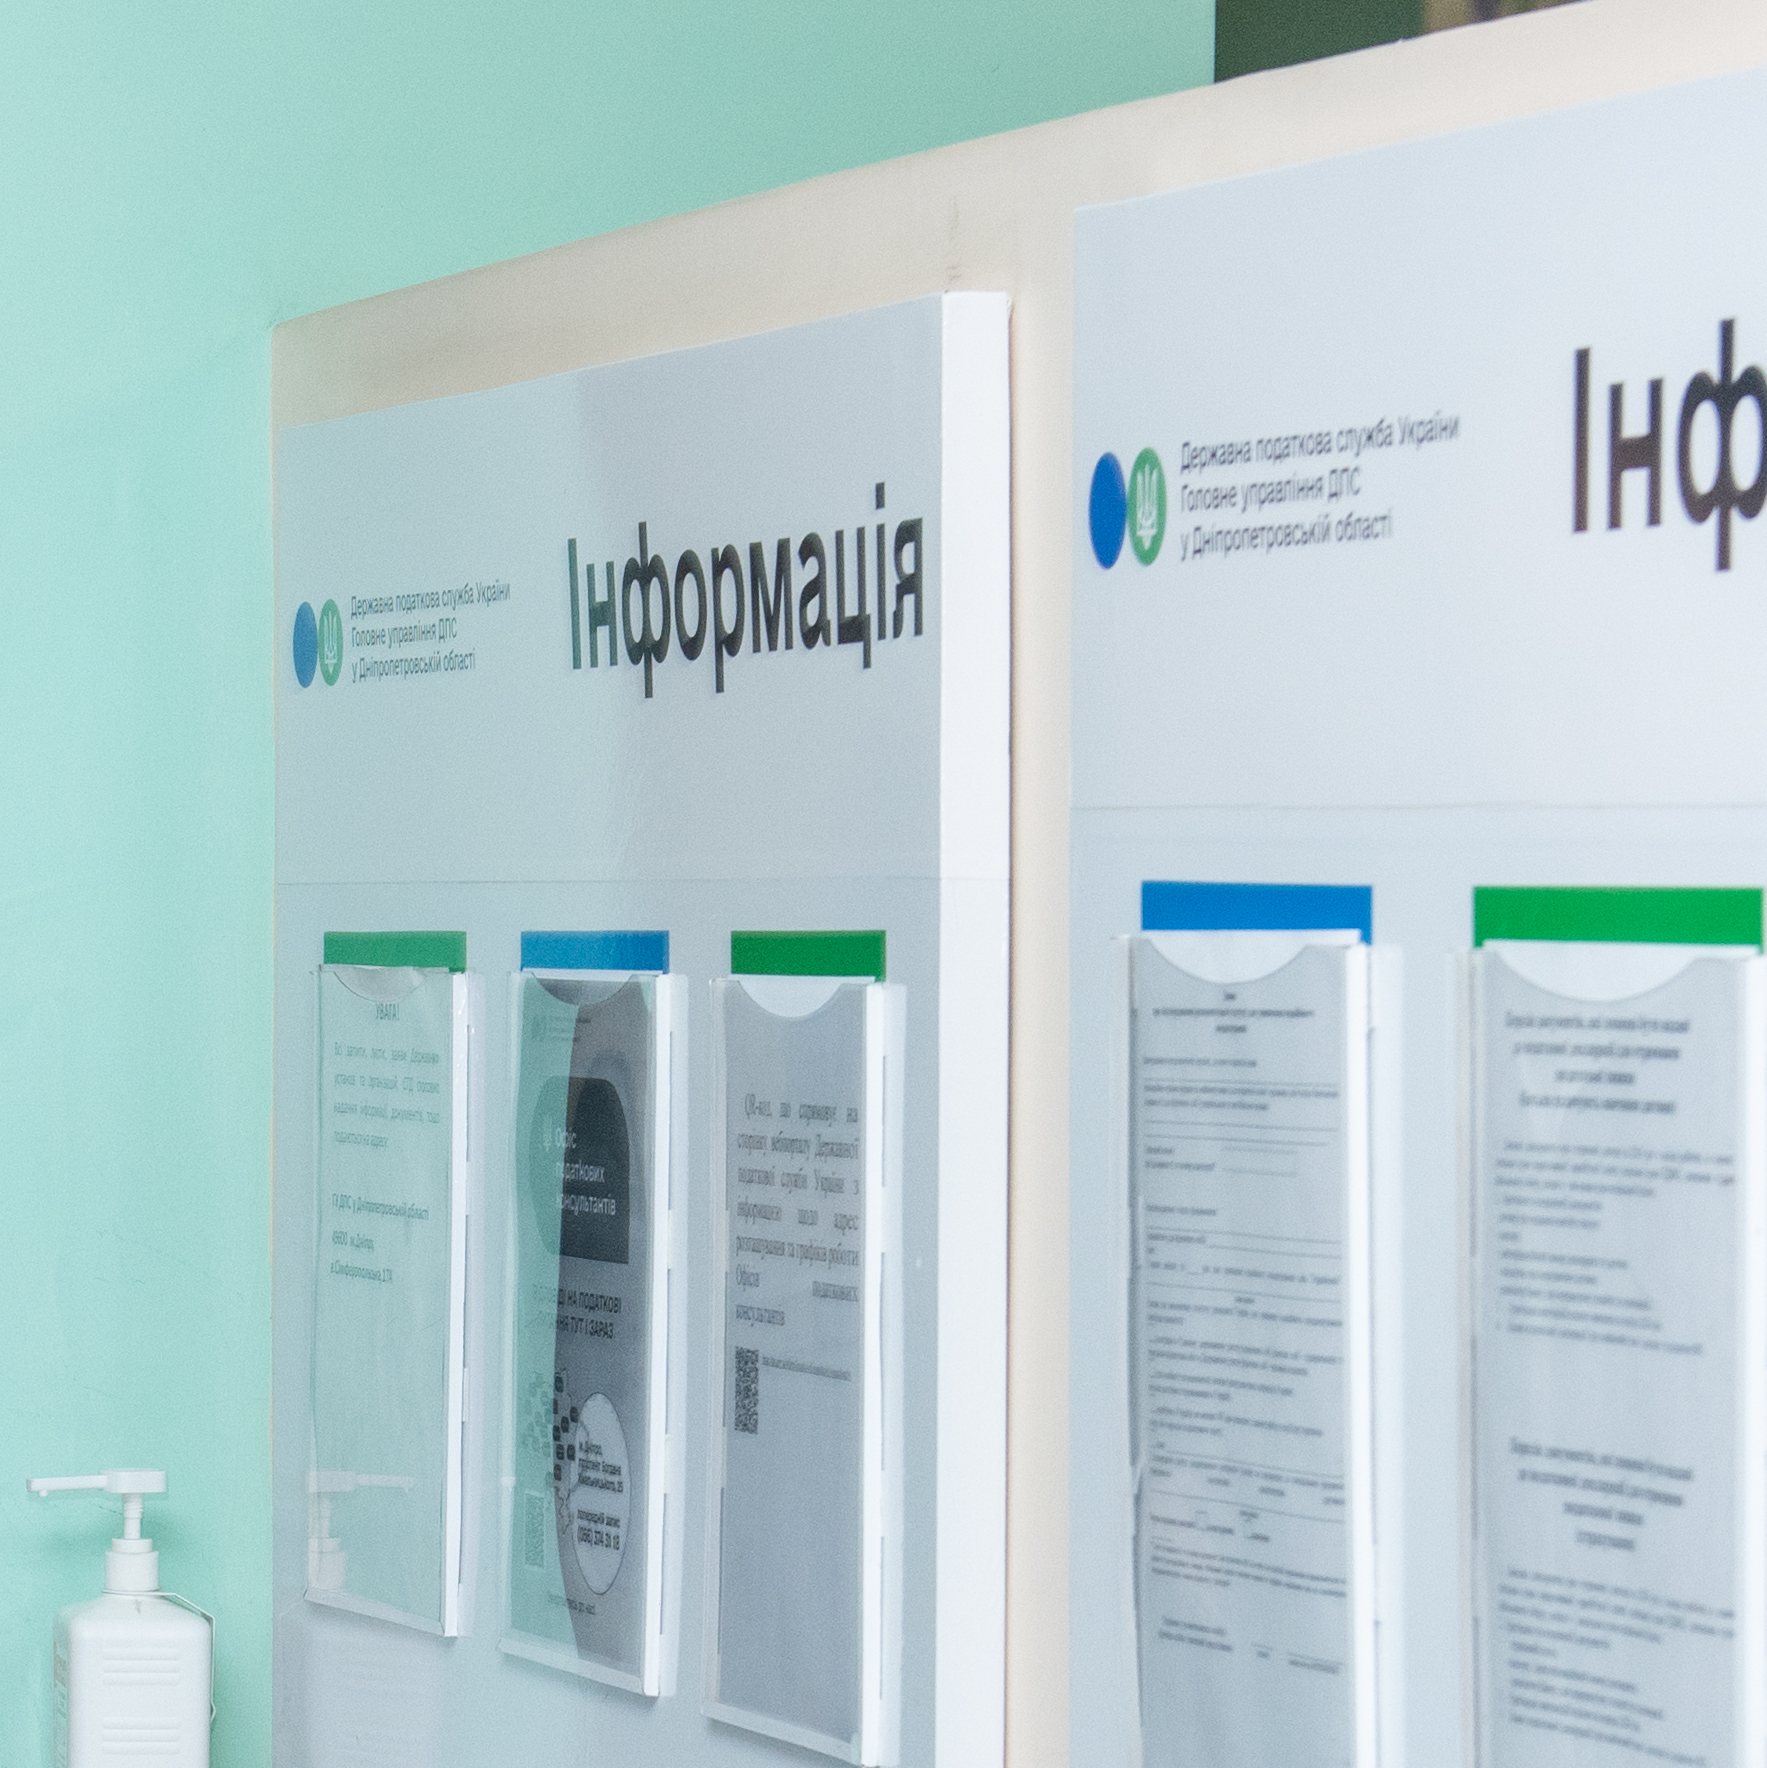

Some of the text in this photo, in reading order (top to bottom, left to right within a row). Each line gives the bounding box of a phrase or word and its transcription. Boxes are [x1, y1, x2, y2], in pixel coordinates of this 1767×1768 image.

[1180, 409, 1460, 474] Державна податкова служба України
[1180, 465, 1362, 514] Головне управління ДПС
[1180, 507, 1395, 563] у Дніпропетровській області
[351, 579, 511, 620] Державна податкова служба України
[567, 482, 923, 699] Інформація
[351, 617, 458, 649] Головне управління ДПС
[351, 647, 476, 684] у Дніпропетровській області
[375, 1003, 400, 1021] УВАГА!
[846, 1107, 858, 1122] на
[737, 1129, 766, 1155] сторінку
[814, 1134, 858, 1160] Державної
[555, 1159, 605, 1181] податкових
[738, 1165, 775, 1186] податкової
[780, 1168, 807, 1192] служби
[813, 1169, 844, 1196] України
[338, 1194, 351, 1210] ДПС
[356, 1196, 406, 1217] Дніпропетровській
[407, 1204, 429, 1219] області
[556, 1185, 615, 1214] консультантів
[797, 1208, 818, 1227] щодо
[833, 1212, 858, 1233] адрес
[787, 1242, 794, 1257] та
[828, 1243, 858, 1268] роботи
[736, 1265, 759, 1292] Офісів
[567, 1289, 621, 1313] НА ПОДАТКОВІ
[570, 1314, 583, 1333] ТУТ
[589, 1318, 613, 1338] ЗАРАЗ
